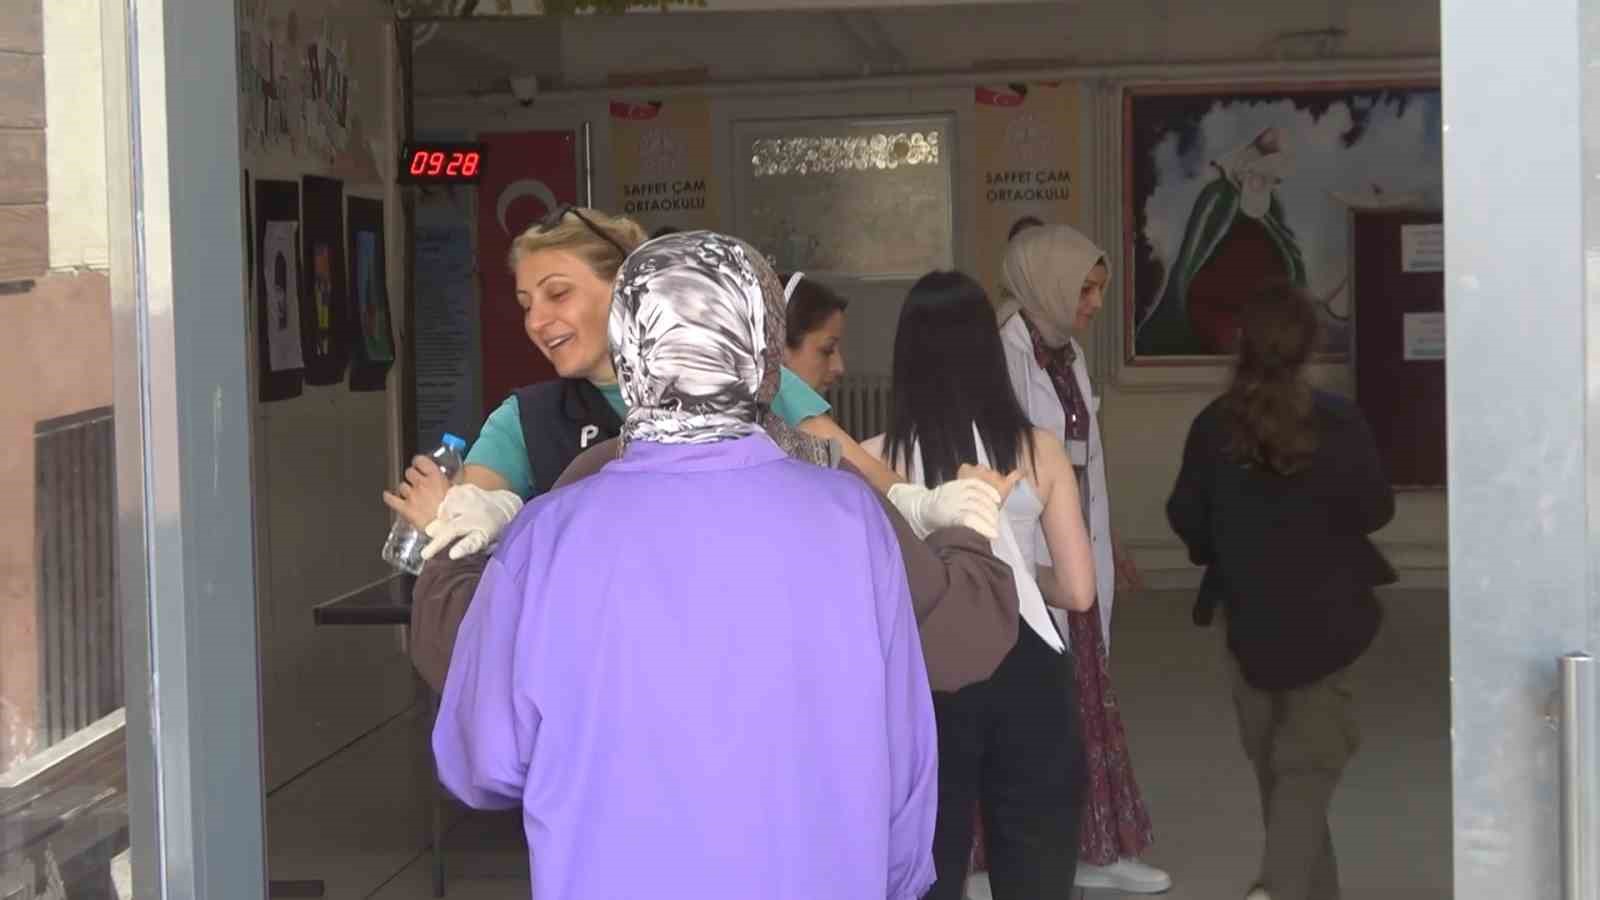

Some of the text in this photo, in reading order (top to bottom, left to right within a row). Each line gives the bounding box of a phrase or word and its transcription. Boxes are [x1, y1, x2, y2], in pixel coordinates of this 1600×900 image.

[985, 170, 1031, 185] SAFFET
[623, 182, 667, 197] SAFFET
[985, 187, 1070, 202] ORTAOKULU
[623, 196, 705, 213] ORTAOKULU
